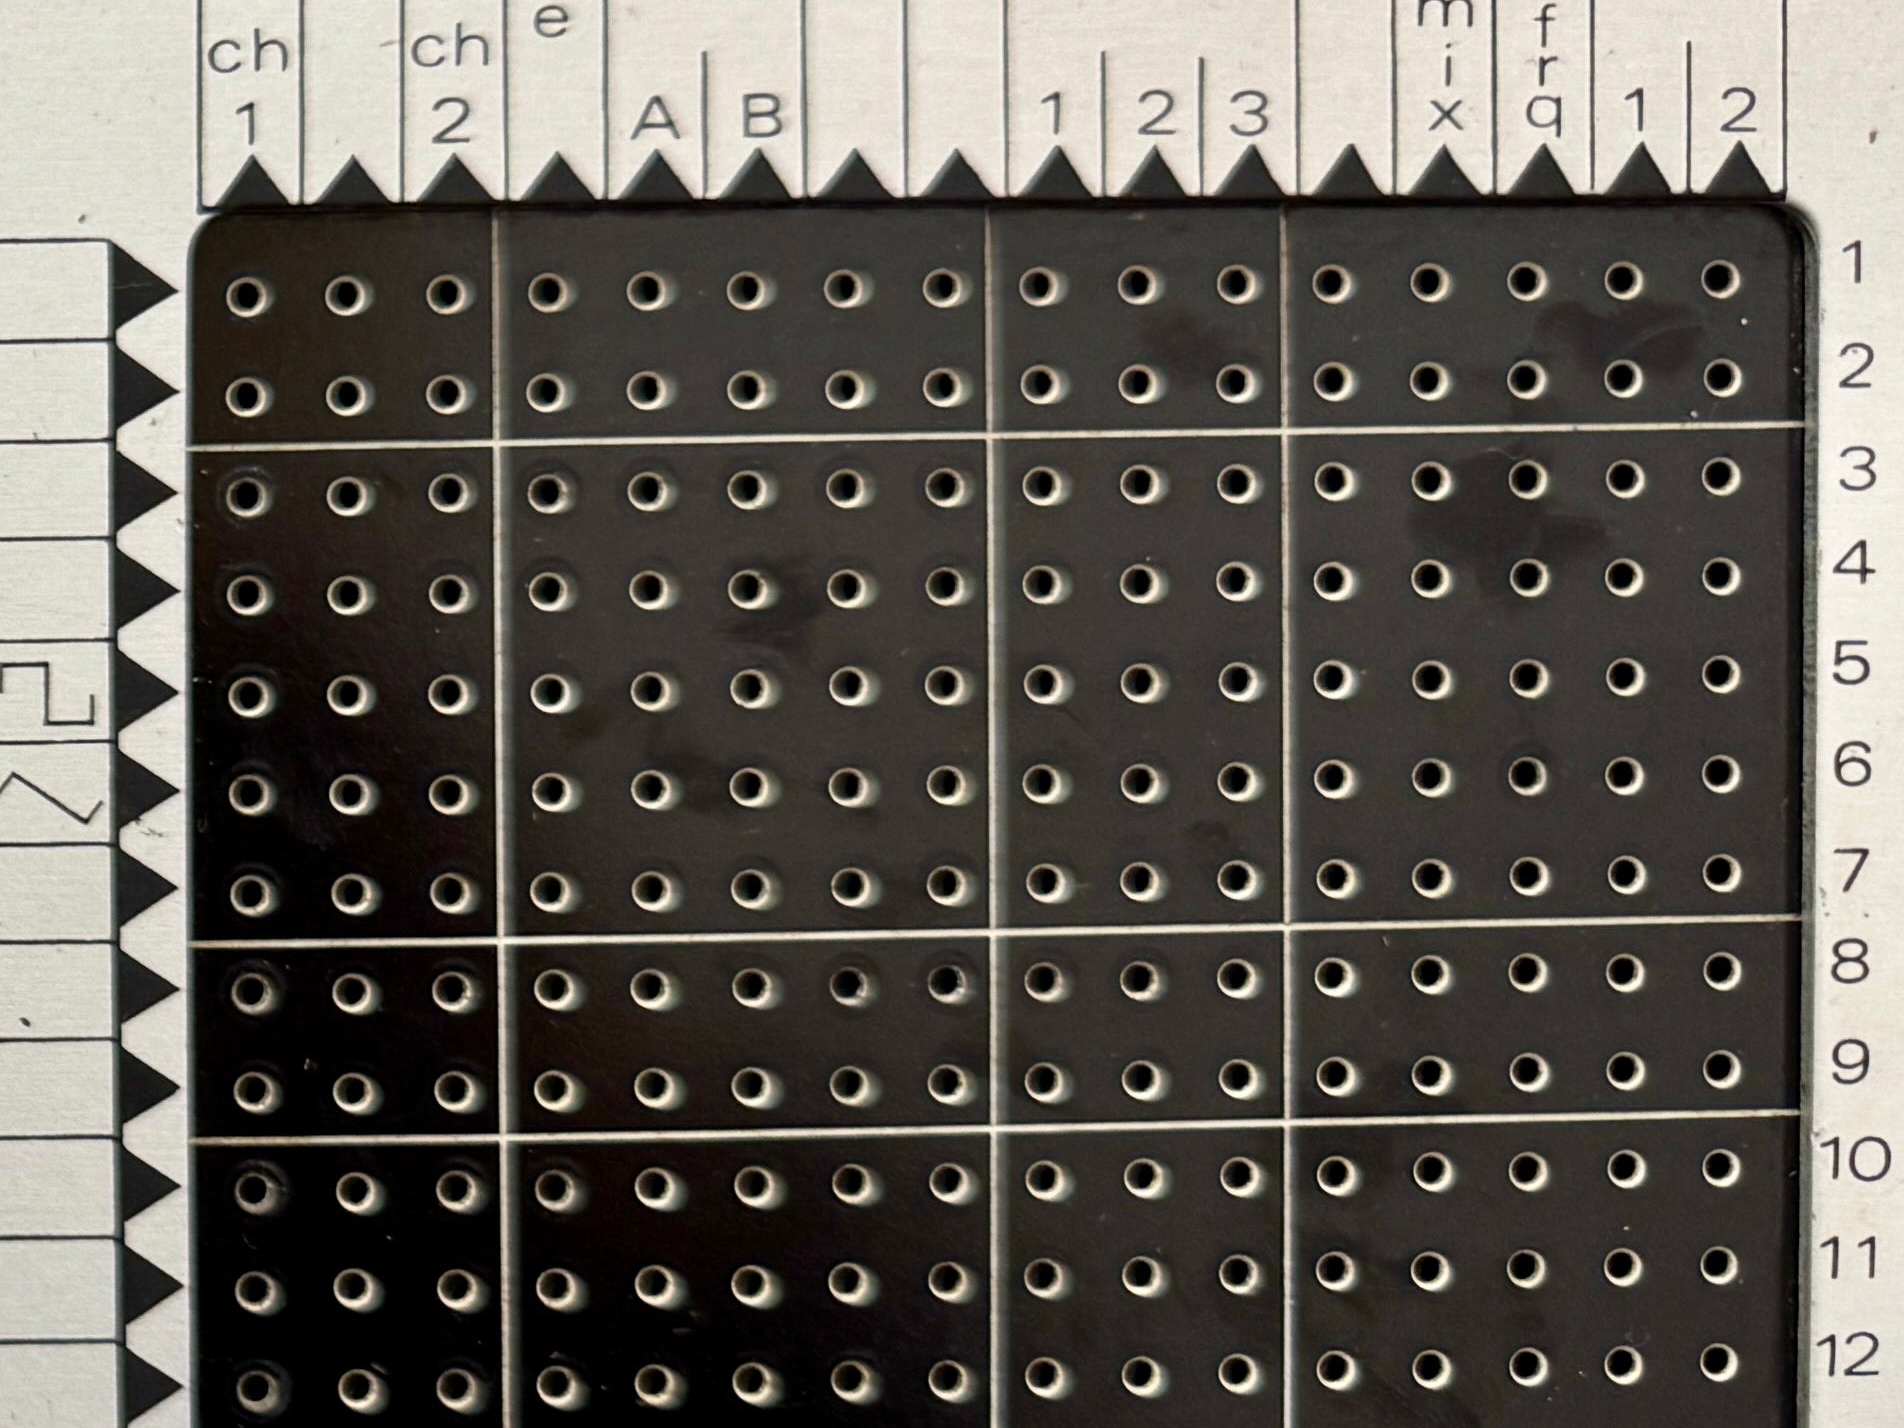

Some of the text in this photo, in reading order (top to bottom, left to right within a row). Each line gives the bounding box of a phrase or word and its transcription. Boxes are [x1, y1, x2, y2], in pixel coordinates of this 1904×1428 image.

[208, 28, 289, 73] ch
[411, 22, 490, 67] ch
[236, 101, 256, 145] 1
[432, 97, 472, 144] 2
[631, 93, 786, 140] A B
[1041, 89, 1269, 137] 1 2 3
[1624, 87, 1757, 132] 1 2
[1842, 240, 1861, 283] 1
[1839, 342, 1874, 388] 2
[1833, 539, 1876, 584] 4
[1833, 848, 1870, 893] 7
[1820, 1136, 1891, 1182] 10
[1816, 1331, 1879, 1377] 12
